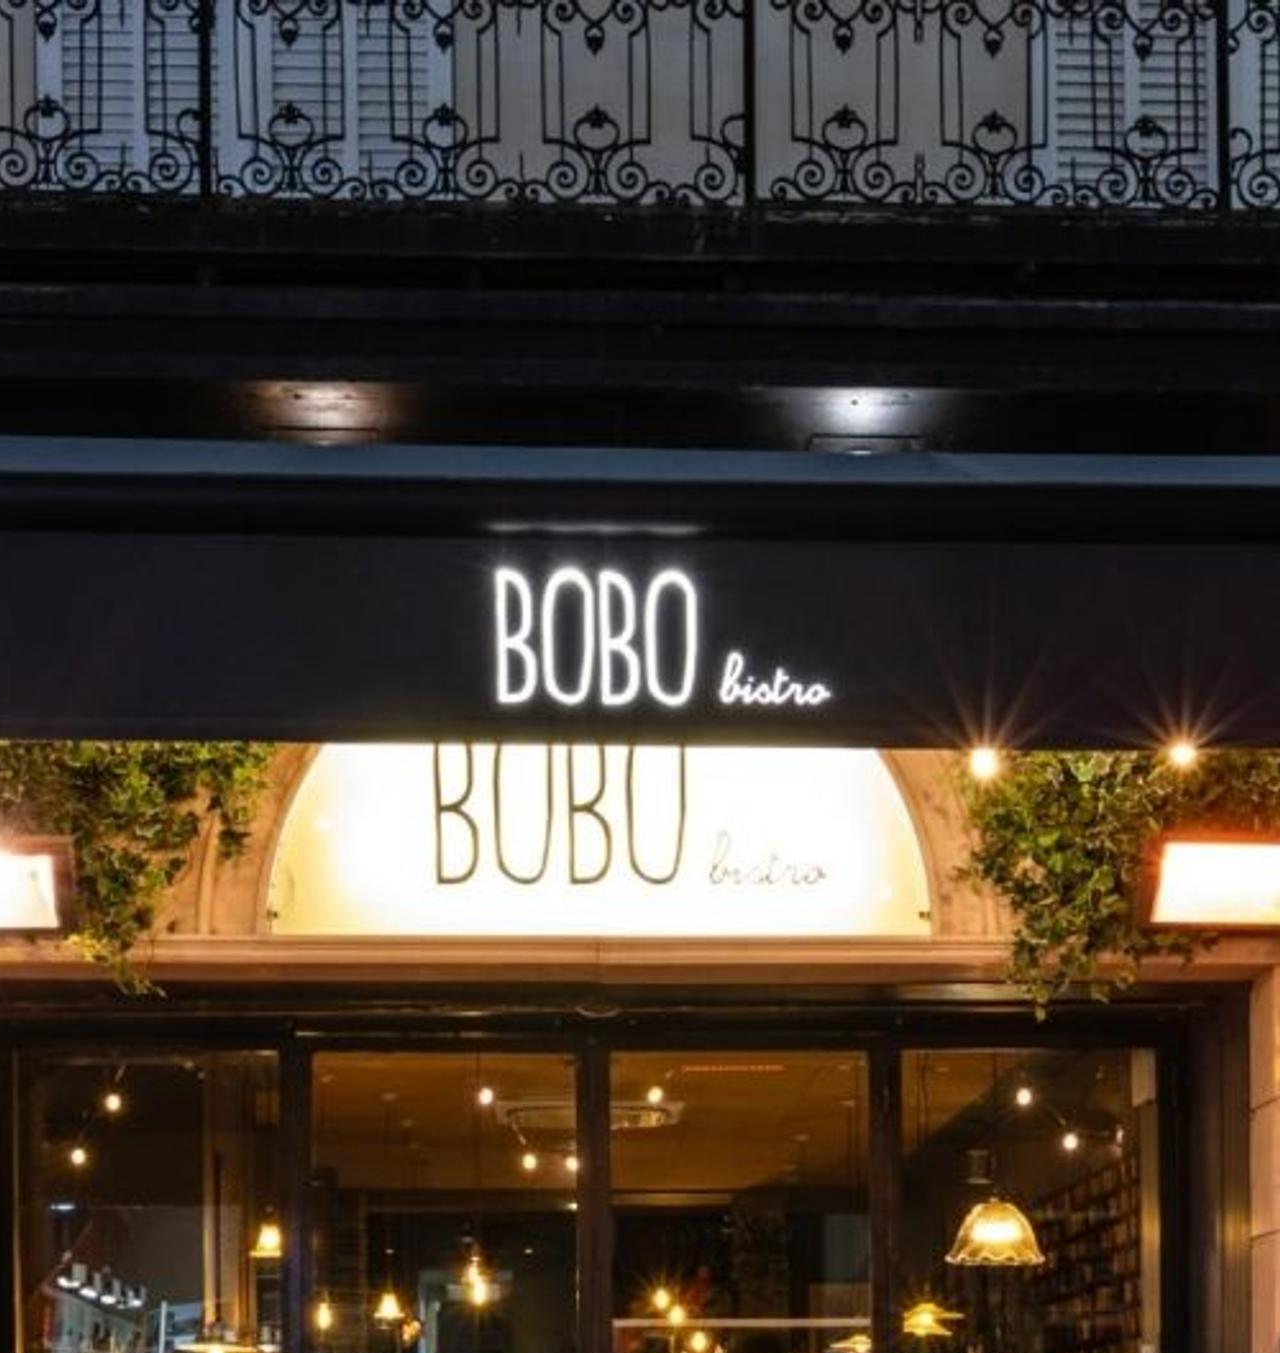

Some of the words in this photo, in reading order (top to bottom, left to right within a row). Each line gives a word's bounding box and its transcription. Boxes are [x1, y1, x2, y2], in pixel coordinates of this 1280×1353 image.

[493, 564, 698, 707] BOBO
[719, 650, 832, 706] bistro
[433, 743, 686, 885] BOBO
[709, 830, 827, 886] bistro
